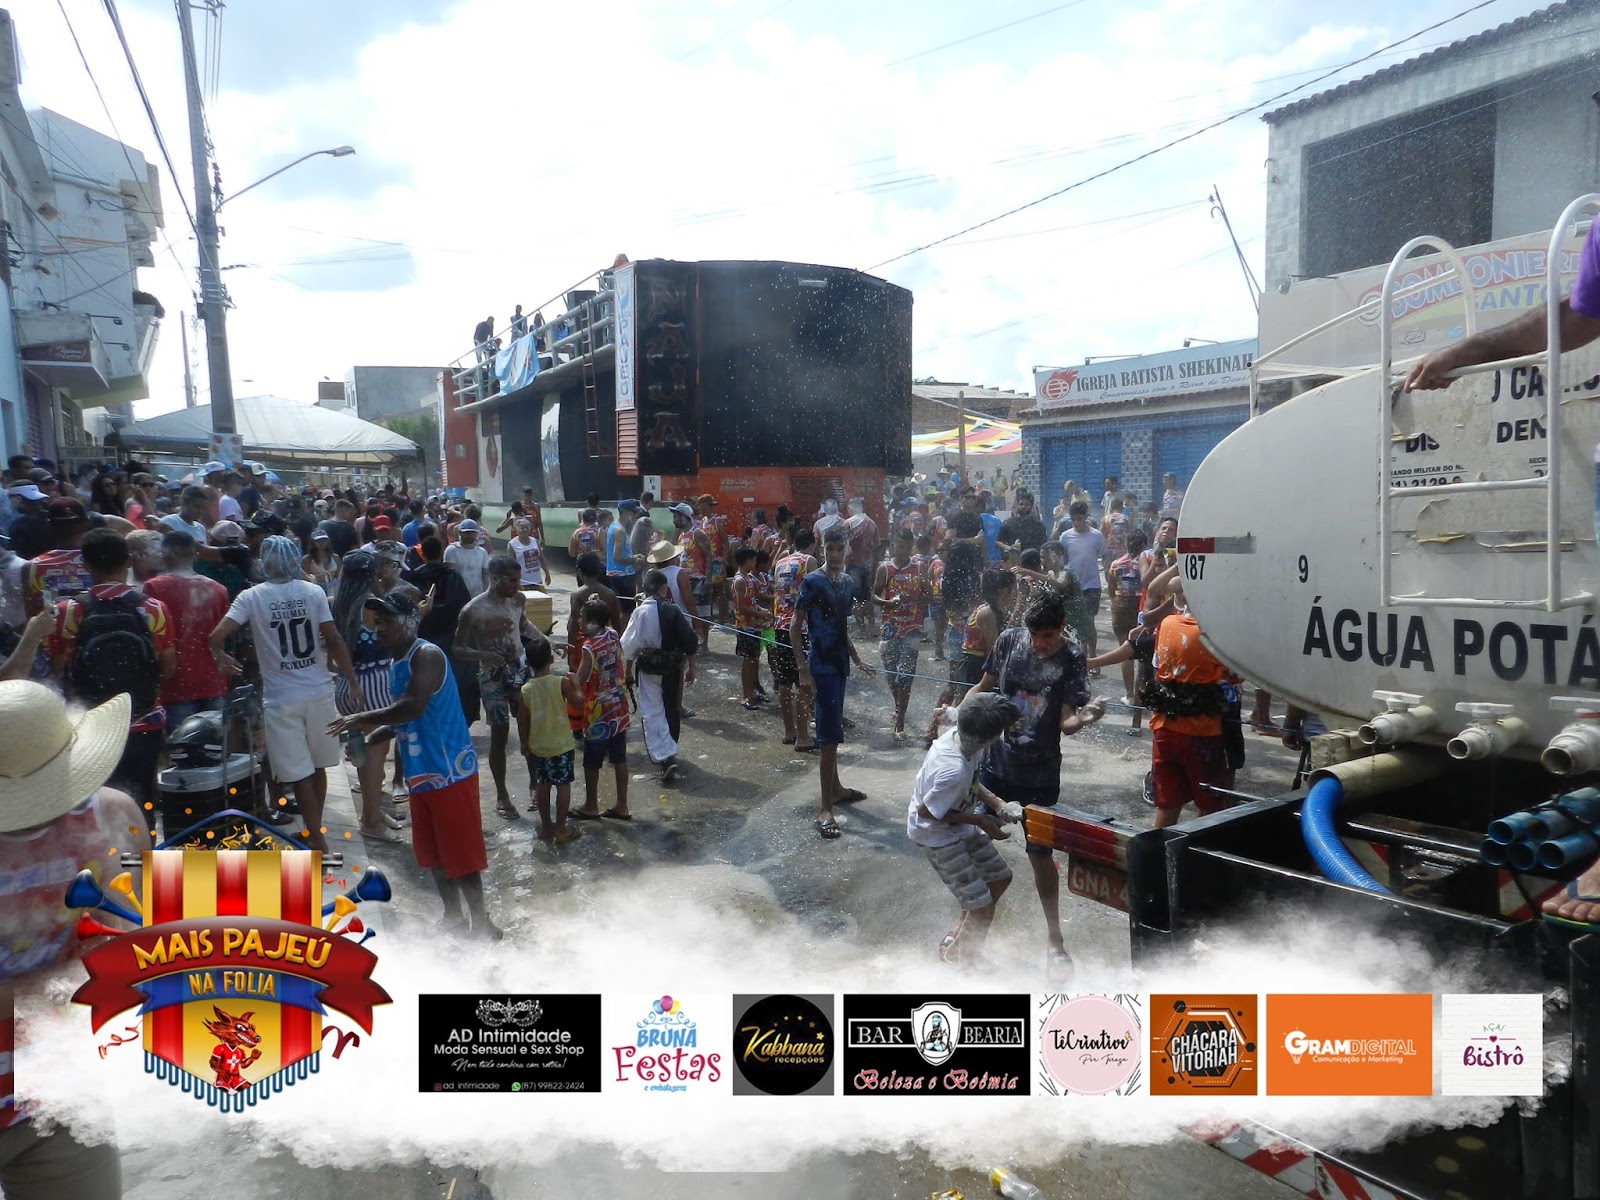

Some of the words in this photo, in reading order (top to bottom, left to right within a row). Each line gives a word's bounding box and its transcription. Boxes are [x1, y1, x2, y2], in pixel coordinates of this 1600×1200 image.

[1076, 373, 1117, 392] IGREJA
[1121, 367, 1175, 386] BATISTA
[1179, 353, 1254, 379] SHEKINAH
[1185, 555, 1206, 580] (87
[1298, 554, 1309, 583] 9
[270, 617, 315, 659] 10
[1303, 596, 1435, 672] ÁGUA
[280, 657, 316, 671] FOXLUX
